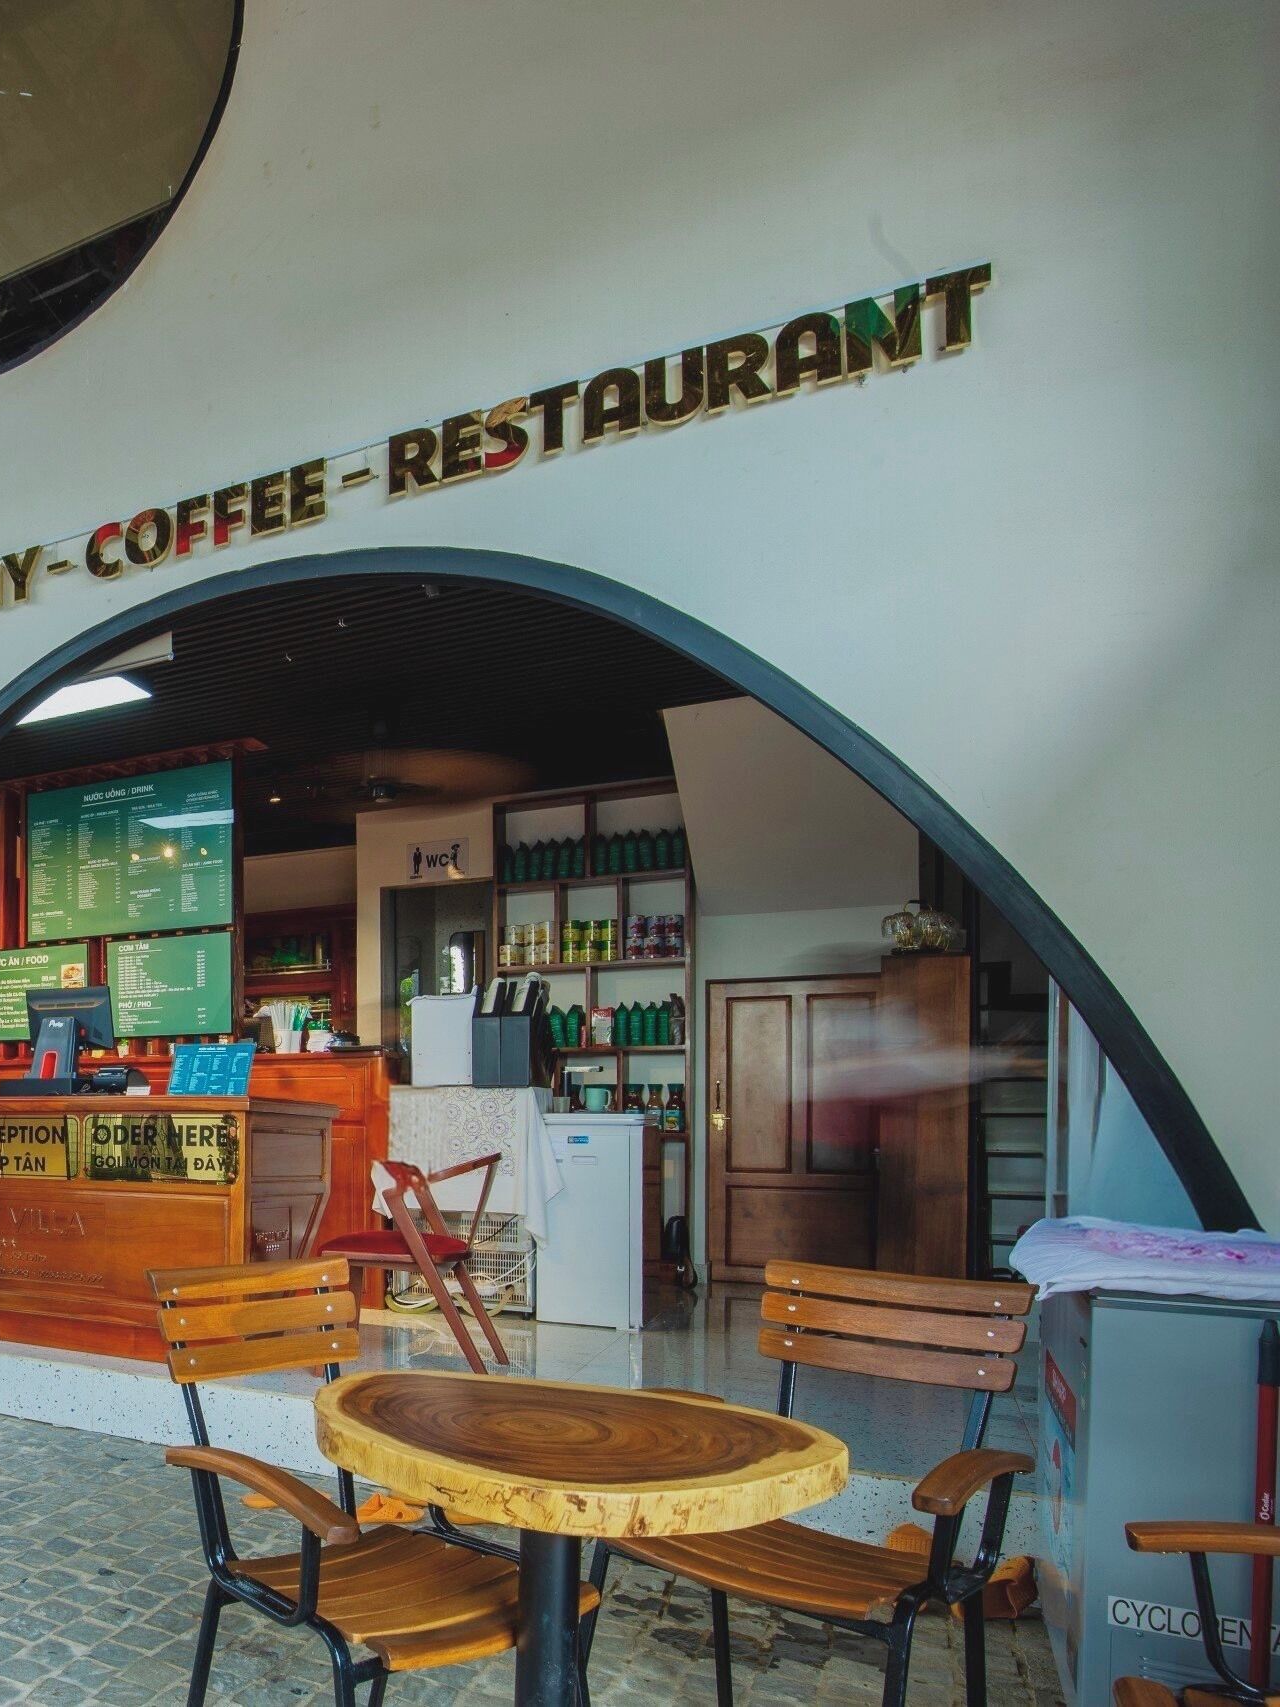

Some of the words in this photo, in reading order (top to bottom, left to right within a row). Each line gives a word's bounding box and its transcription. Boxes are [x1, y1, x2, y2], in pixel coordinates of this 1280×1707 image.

[86, 459, 328, 579] COFFEE
[388, 262, 992, 496] RESTAURANT
[131, 784, 154, 795] DRINK
[426, 854, 449, 868] WC
[26, 955, 49, 965] FOOD
[93, 1125, 158, 1146] ODER
[167, 1125, 228, 1147] HERE
[13, 1152, 46, 1172] TÂN
[193, 1154, 227, 1172] ĐÂY
[9, 1207, 86, 1236] VILLA
